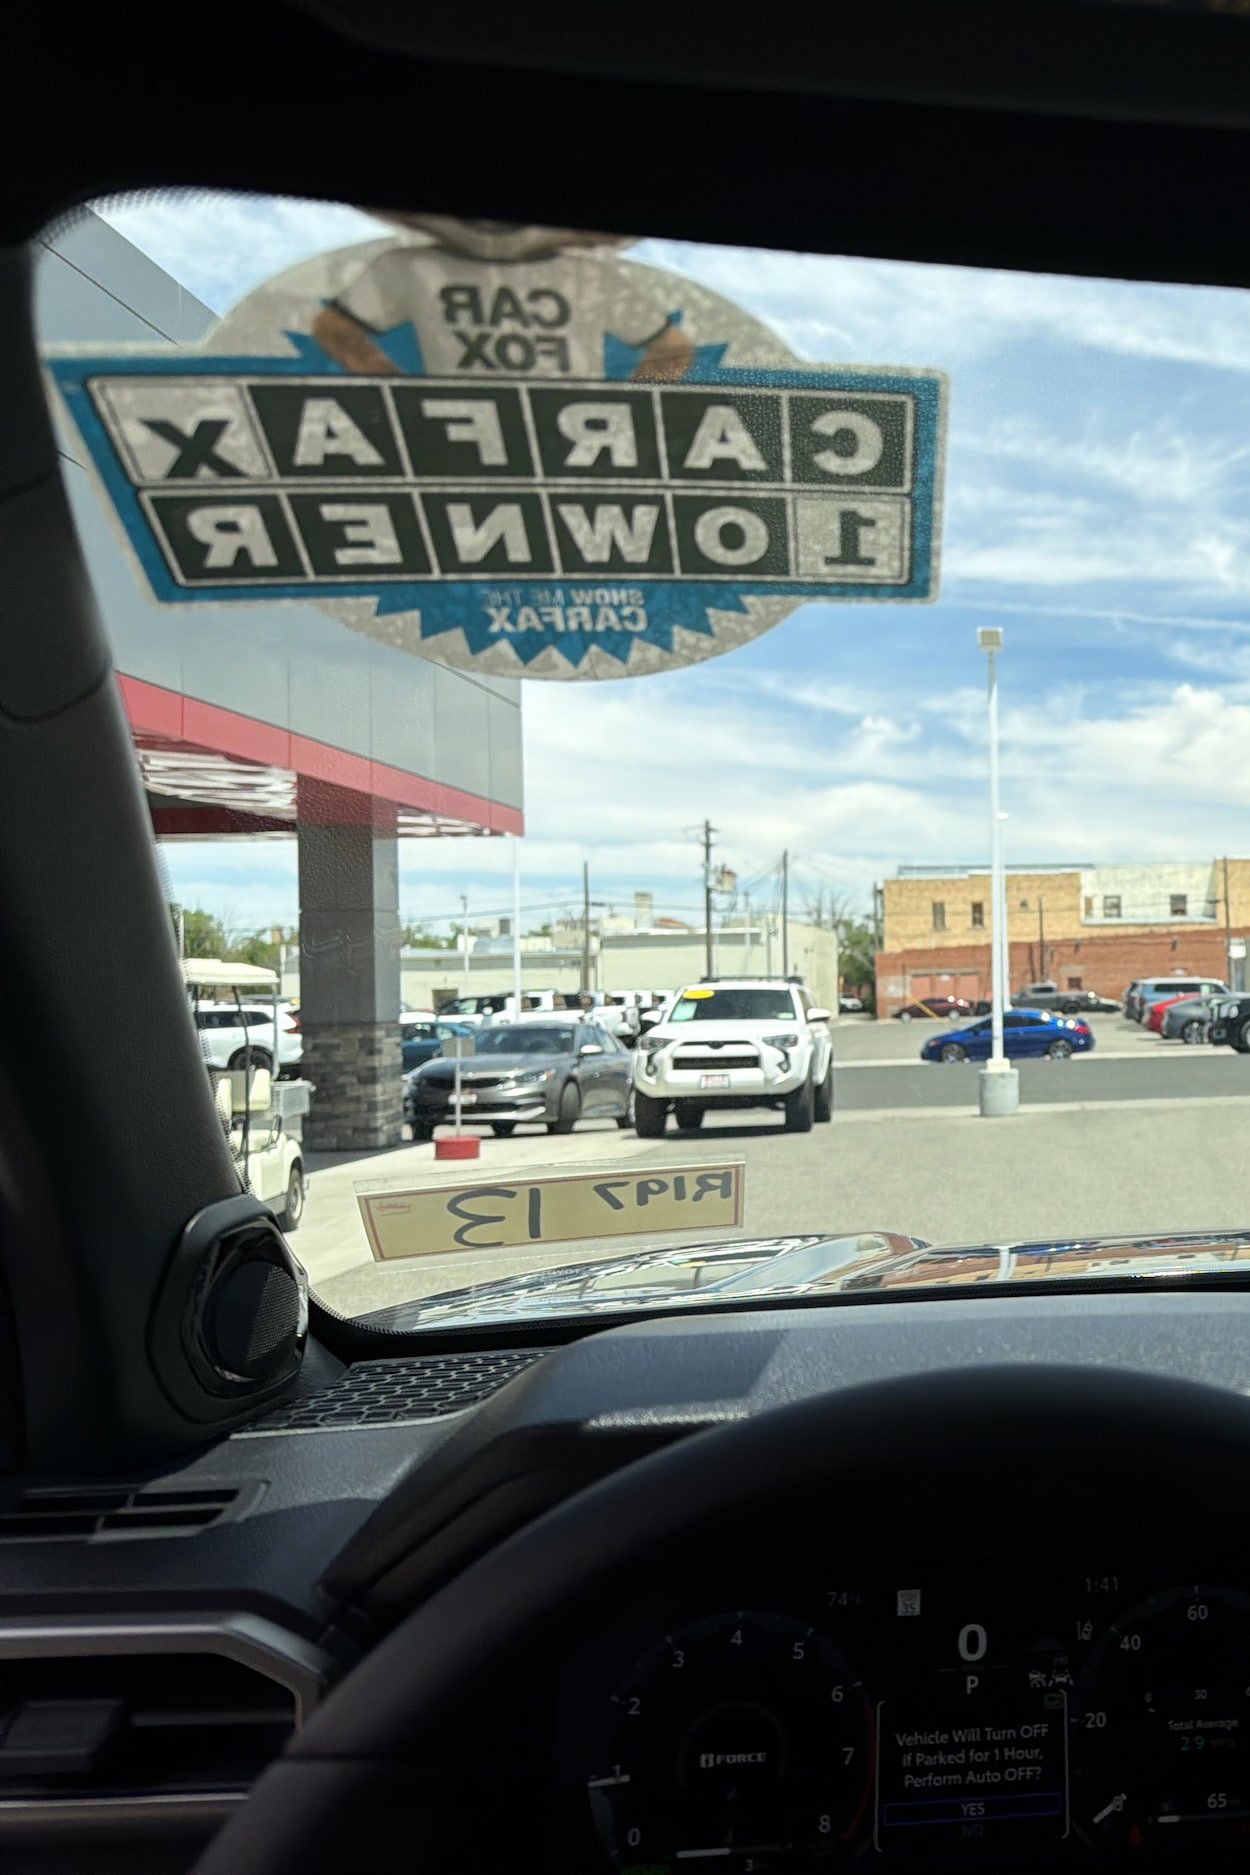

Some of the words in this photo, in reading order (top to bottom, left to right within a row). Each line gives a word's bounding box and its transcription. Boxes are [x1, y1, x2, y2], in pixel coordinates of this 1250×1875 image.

[1084, 1576, 1119, 1592] 1:41
[1187, 1604, 1208, 1620] 60
[730, 1629, 743, 1646] 4
[958, 1623, 988, 1662] 0
[1120, 1635, 1141, 1650] 40
[672, 1650, 685, 1668] 3
[792, 1642, 805, 1660] 5
[831, 1685, 844, 1702] 6
[966, 1675, 979, 1695] P
[627, 1697, 640, 1715] 2
[1085, 1712, 1106, 1728] 20
[896, 1730, 949, 1746] Vehicle
[952, 1728, 980, 1743] Will
[985, 1727, 1016, 1742] Turn
[1020, 1724, 1048, 1738] OFF
[841, 1747, 855, 1765] 7
[902, 1753, 914, 1768] If
[916, 1751, 965, 1767] Parked
[969, 1749, 990, 1763] for
[994, 1748, 1000, 1761] 1
[1004, 1747, 1043, 1762] Hour,
[904, 1773, 961, 1788] Perform
[965, 1770, 1000, 1785] Auto
[1004, 1767, 1042, 1782] OFF?
[961, 1803, 985, 1816] YES
[1207, 1793, 1227, 1808] 65
[818, 1815, 831, 1833] 8
[627, 1828, 640, 1846] 0
